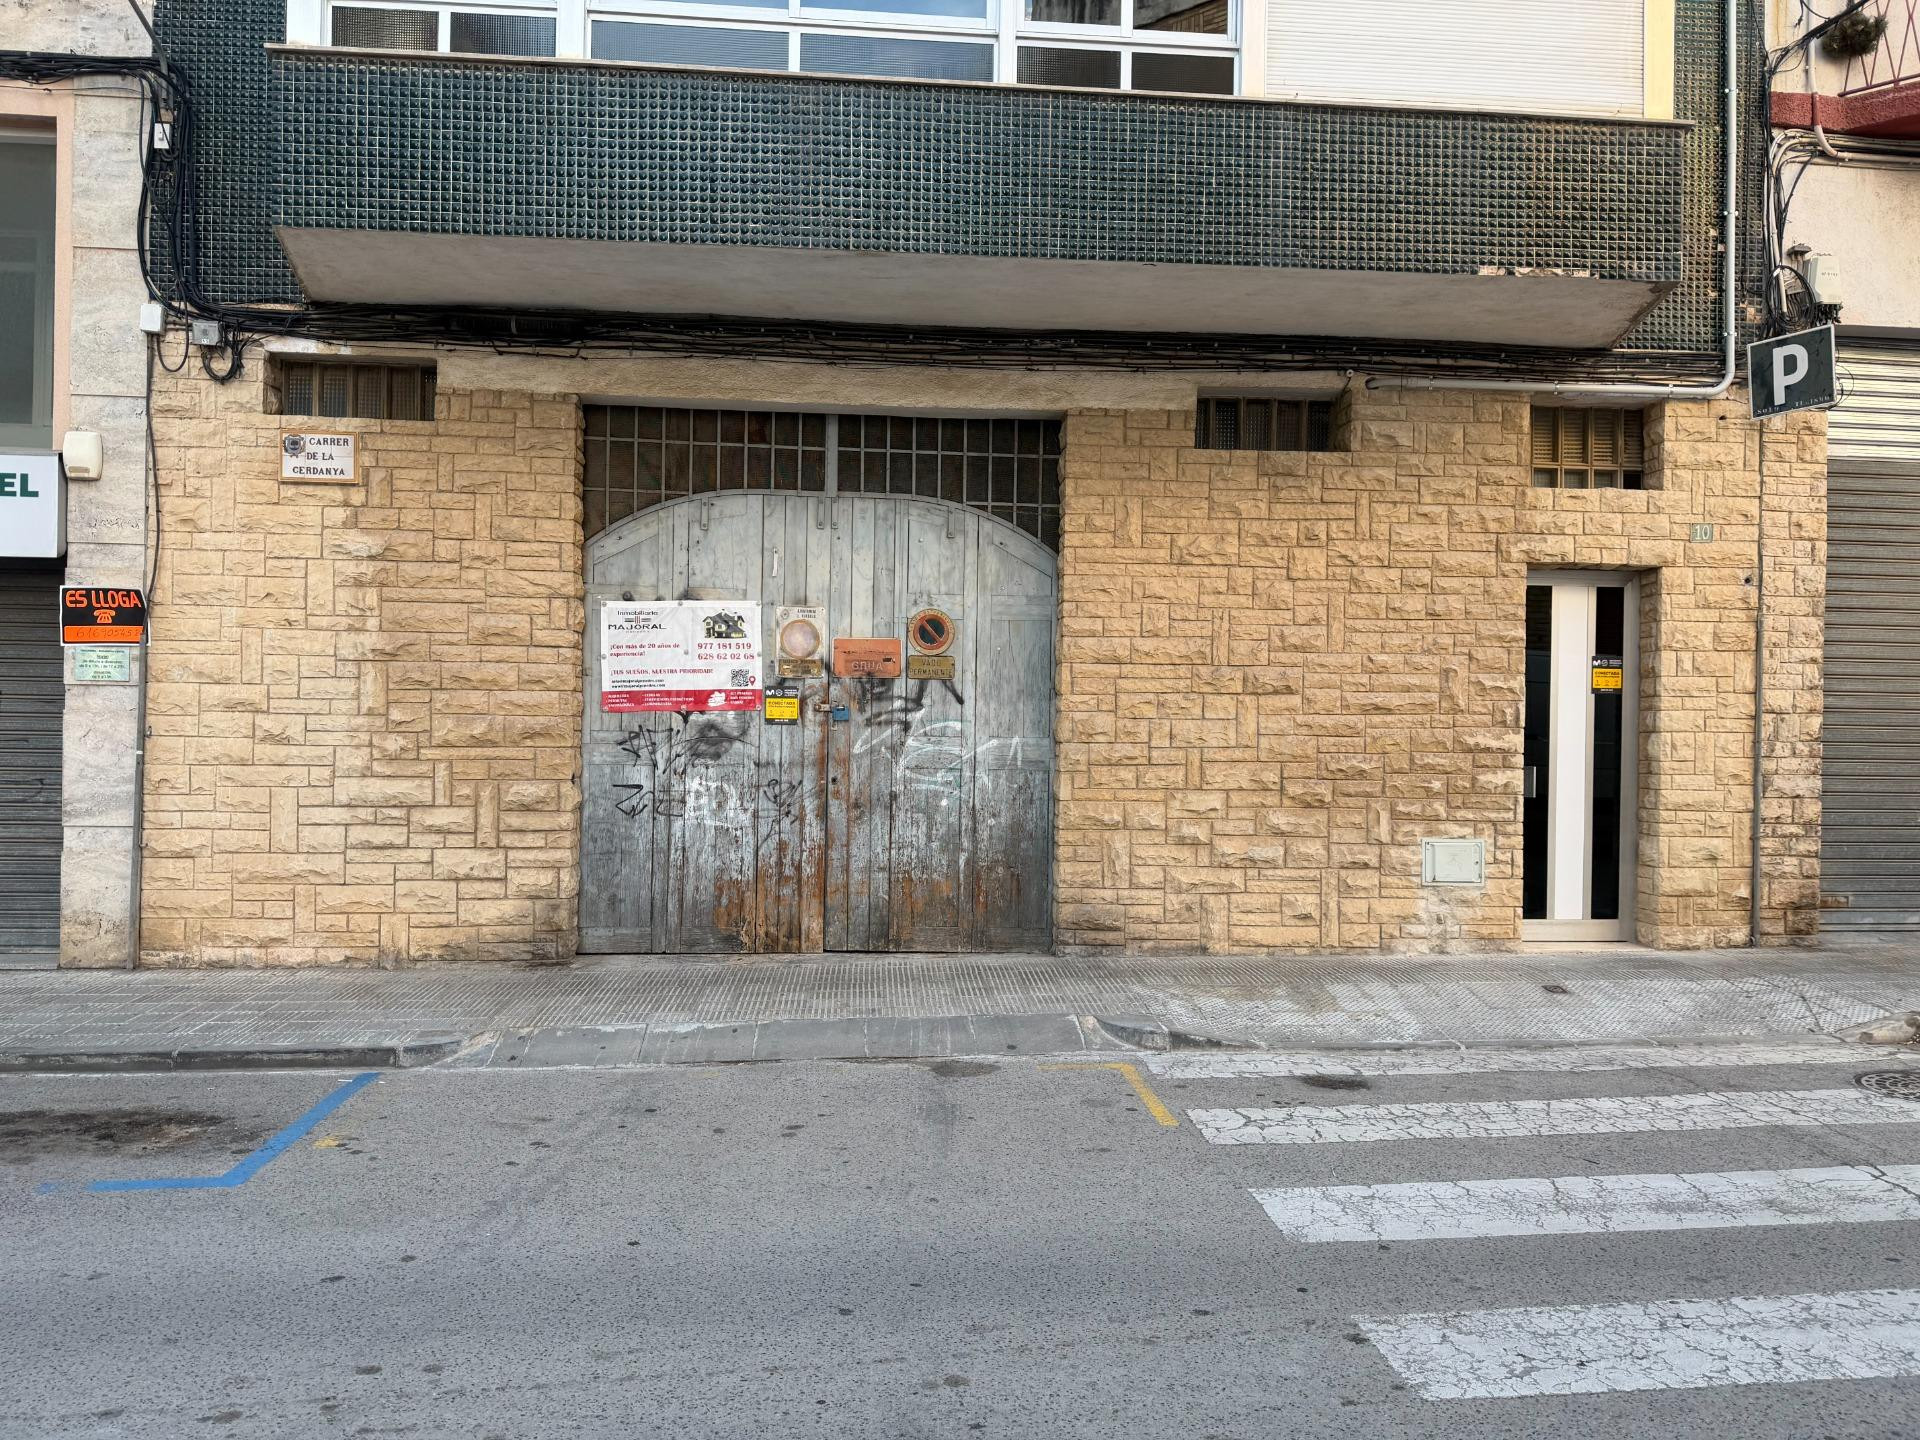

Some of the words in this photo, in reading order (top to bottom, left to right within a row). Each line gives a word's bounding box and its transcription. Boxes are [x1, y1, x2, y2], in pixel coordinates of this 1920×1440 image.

[1773, 344, 1808, 406] P
[309, 437, 349, 446] CARRER
[306, 452, 318, 460] DE
[322, 452, 334, 460] LA
[292, 466, 345, 475] CERDANYA
[1695, 525, 1710, 540] 10
[65, 590, 88, 608] ES
[91, 590, 142, 608] LLOGA
[697, 642, 714, 650] 977
[717, 642, 732, 650] 181
[735, 642, 752, 650] 519
[697, 652, 714, 660] 628
[717, 652, 728, 660] 62
[730, 652, 741, 660] 02
[851, 660, 884, 671] GRUA
[909, 668, 952, 676] PERMANENTE
